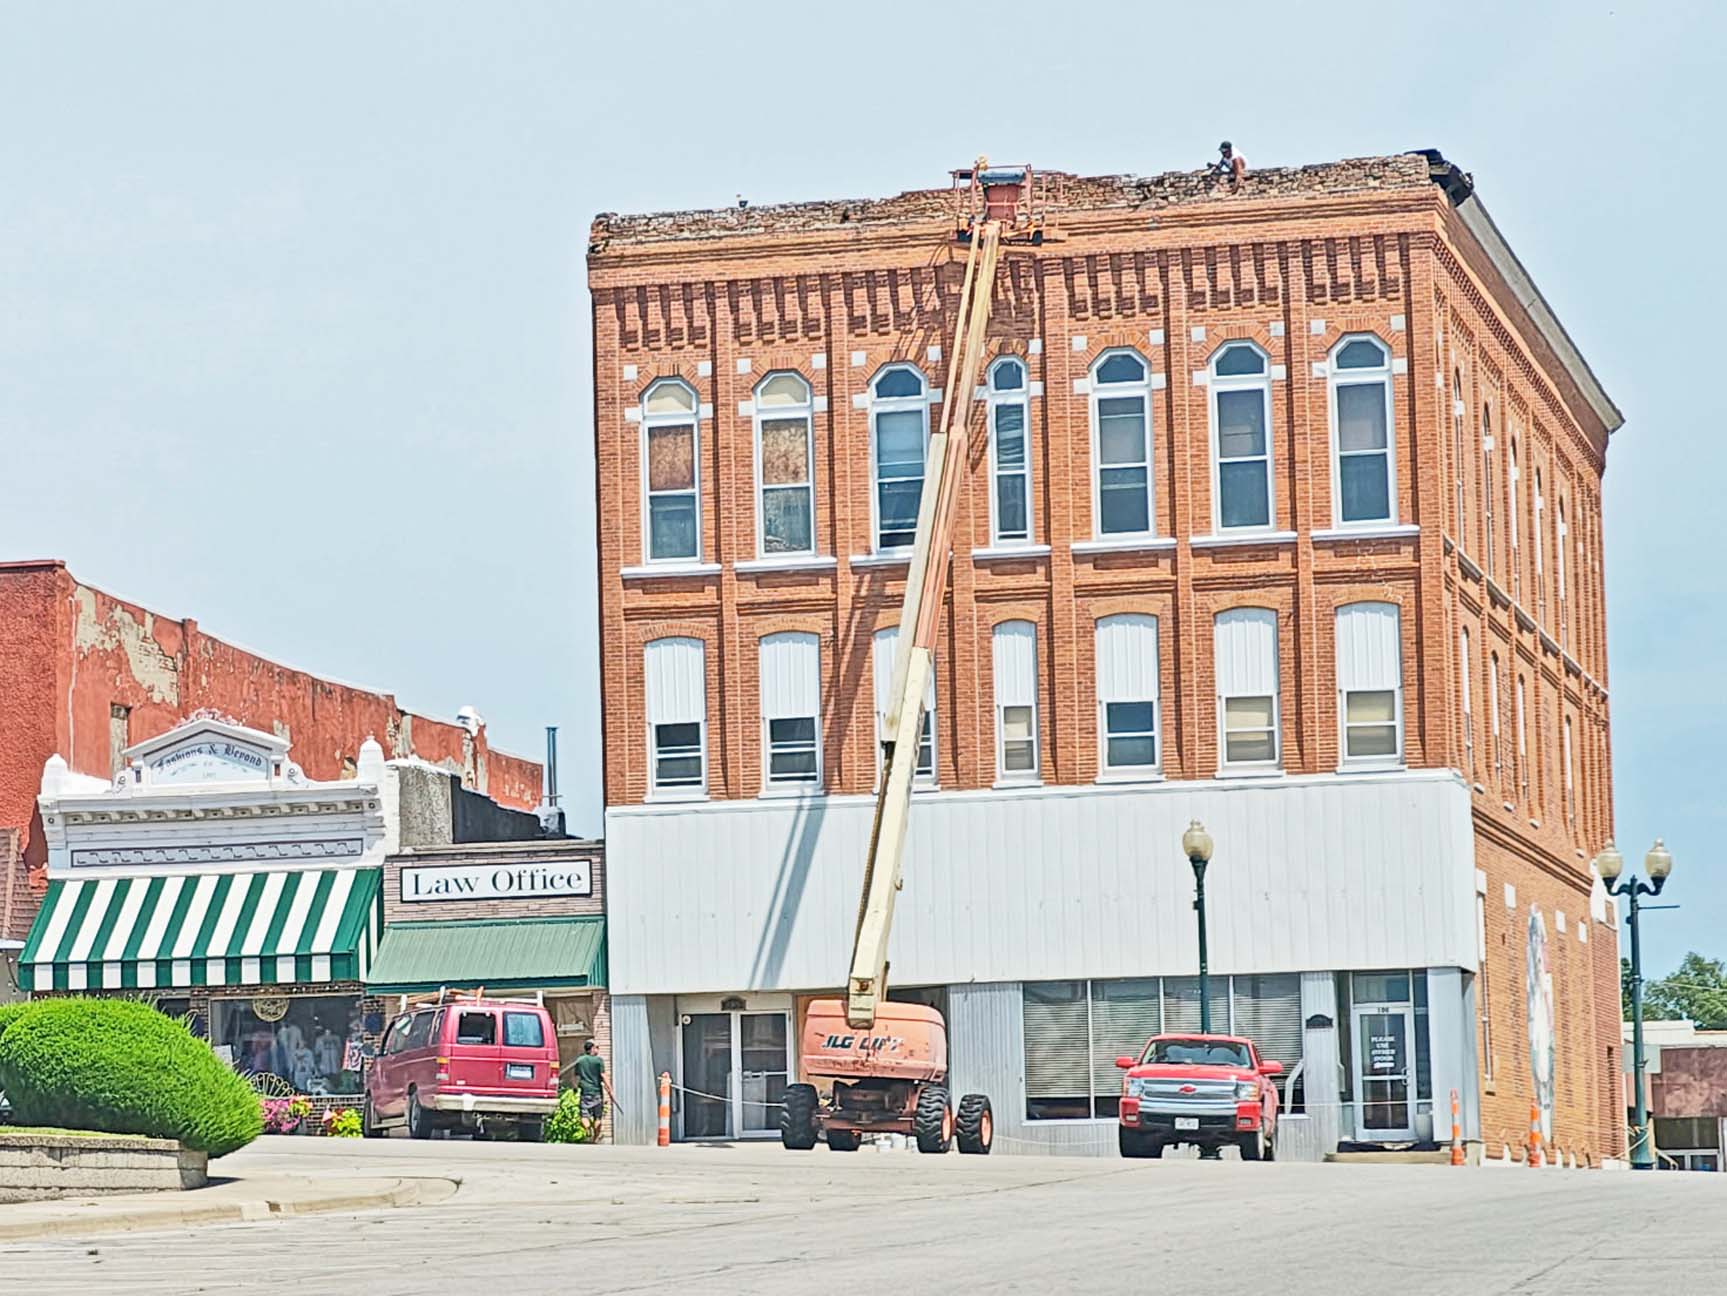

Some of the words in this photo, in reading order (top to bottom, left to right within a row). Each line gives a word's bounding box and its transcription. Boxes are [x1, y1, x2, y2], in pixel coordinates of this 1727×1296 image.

[413, 873, 479, 895] Law
[491, 868, 582, 892] Office
[822, 1035, 855, 1049] JLG
